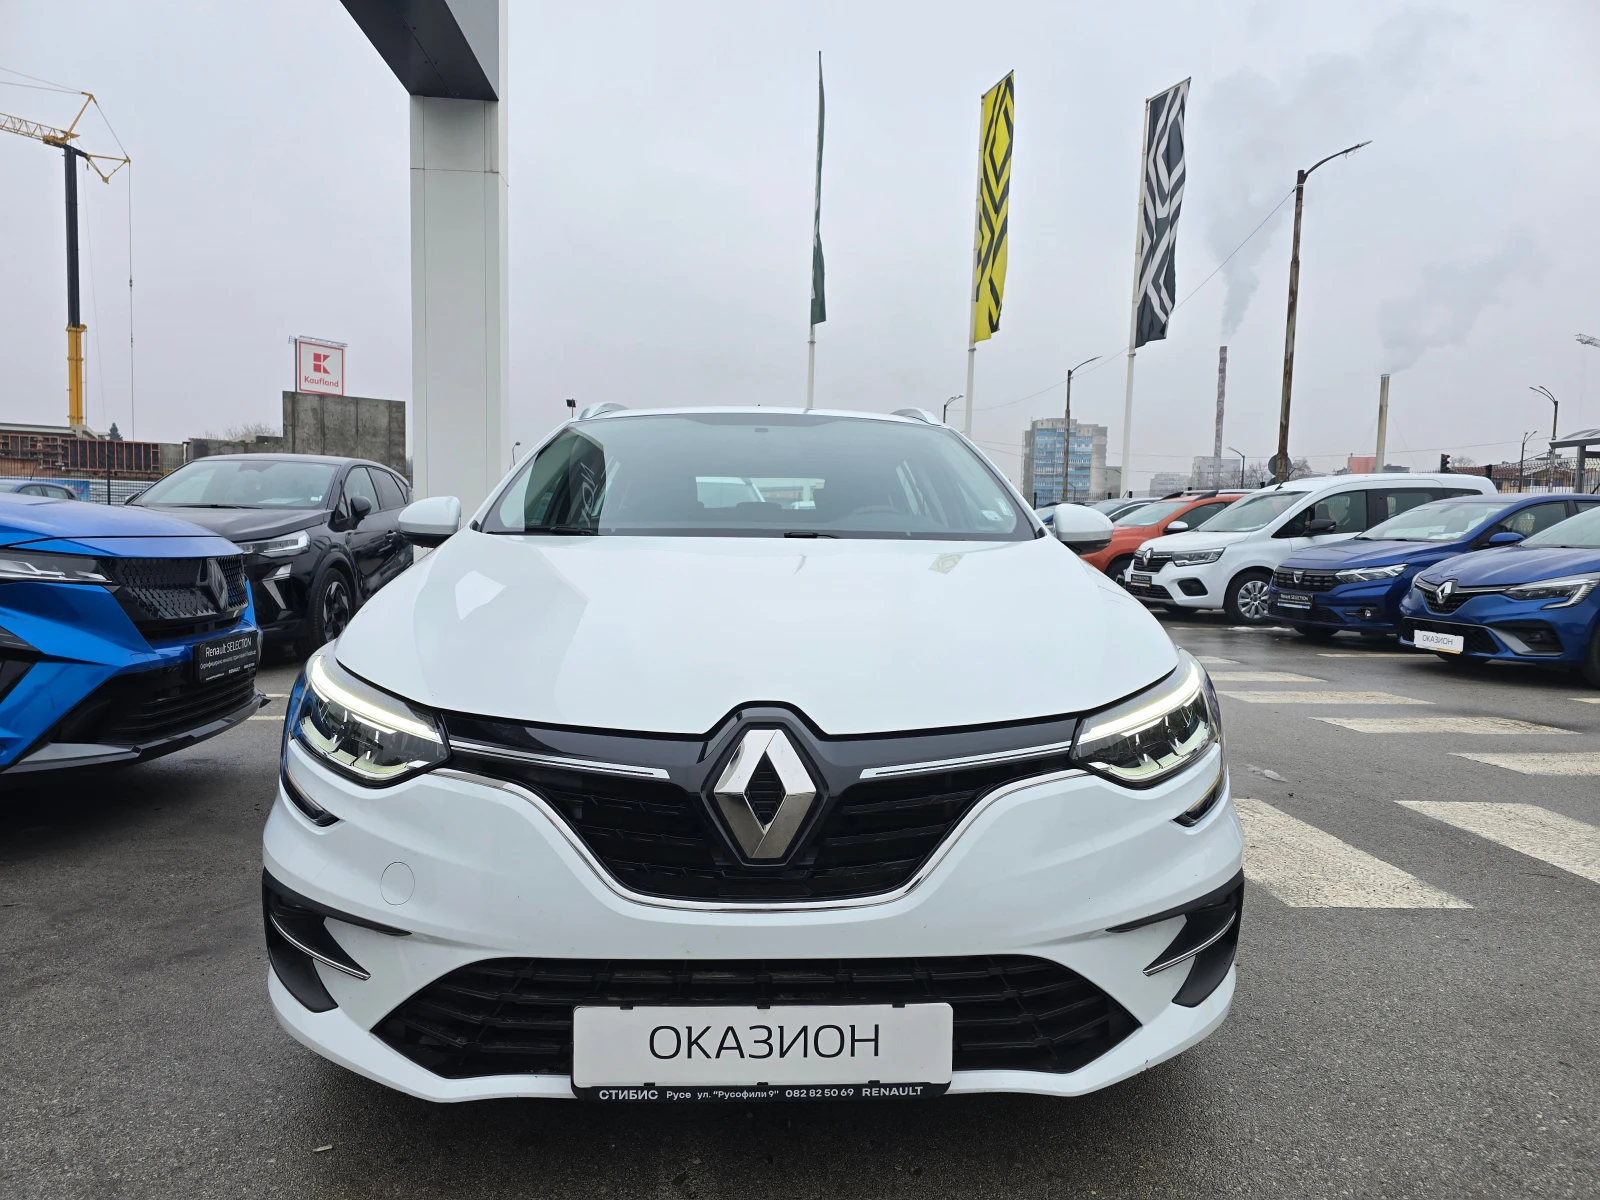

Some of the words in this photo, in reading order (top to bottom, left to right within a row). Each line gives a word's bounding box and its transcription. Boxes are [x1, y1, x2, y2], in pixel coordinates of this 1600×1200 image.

[304, 375, 339, 387] Kaufland
[205, 643, 226, 657] Renault
[227, 637, 251, 652] SELECTION
[1422, 634, 1454, 646] ОКАЗИОН
[649, 1023, 880, 1060] ОКАЗИОН
[598, 1089, 659, 1100] СТИБИС
[666, 1090, 692, 1101] Русе
[697, 1091, 711, 1100] ул.
[862, 1086, 924, 1097] RENAULT
